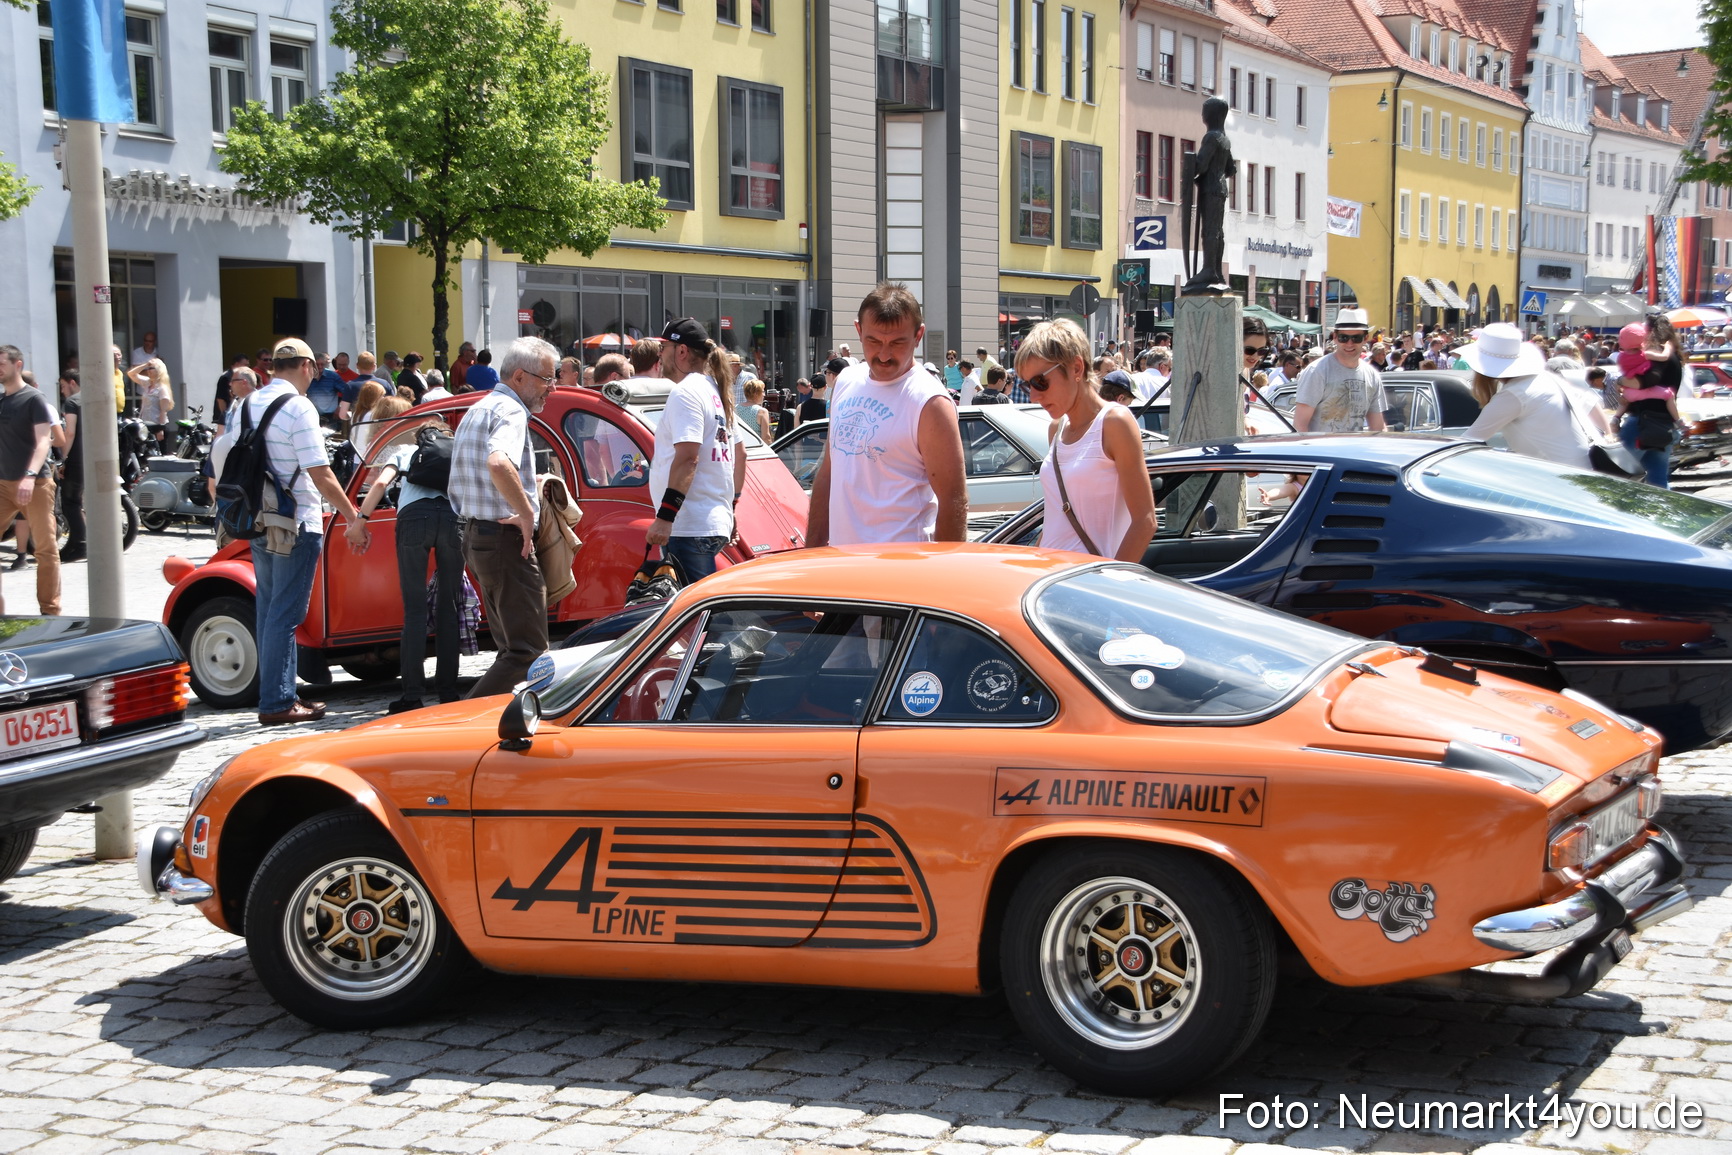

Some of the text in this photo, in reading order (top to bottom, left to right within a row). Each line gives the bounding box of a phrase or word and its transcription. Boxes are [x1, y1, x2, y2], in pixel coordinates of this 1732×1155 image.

[1247, 237, 1287, 258] Buchhandlung
[863, 397, 894, 421] CREST
[1137, 675, 1149, 684] 38
[907, 696, 935, 706] Alpine
[4, 706, 74, 747] 06251
[1047, 779, 1126, 807] ALPINE
[1131, 782, 1235, 814] RENAULT
[193, 844, 205, 855] elf
[1329, 877, 1436, 943] Gotti
